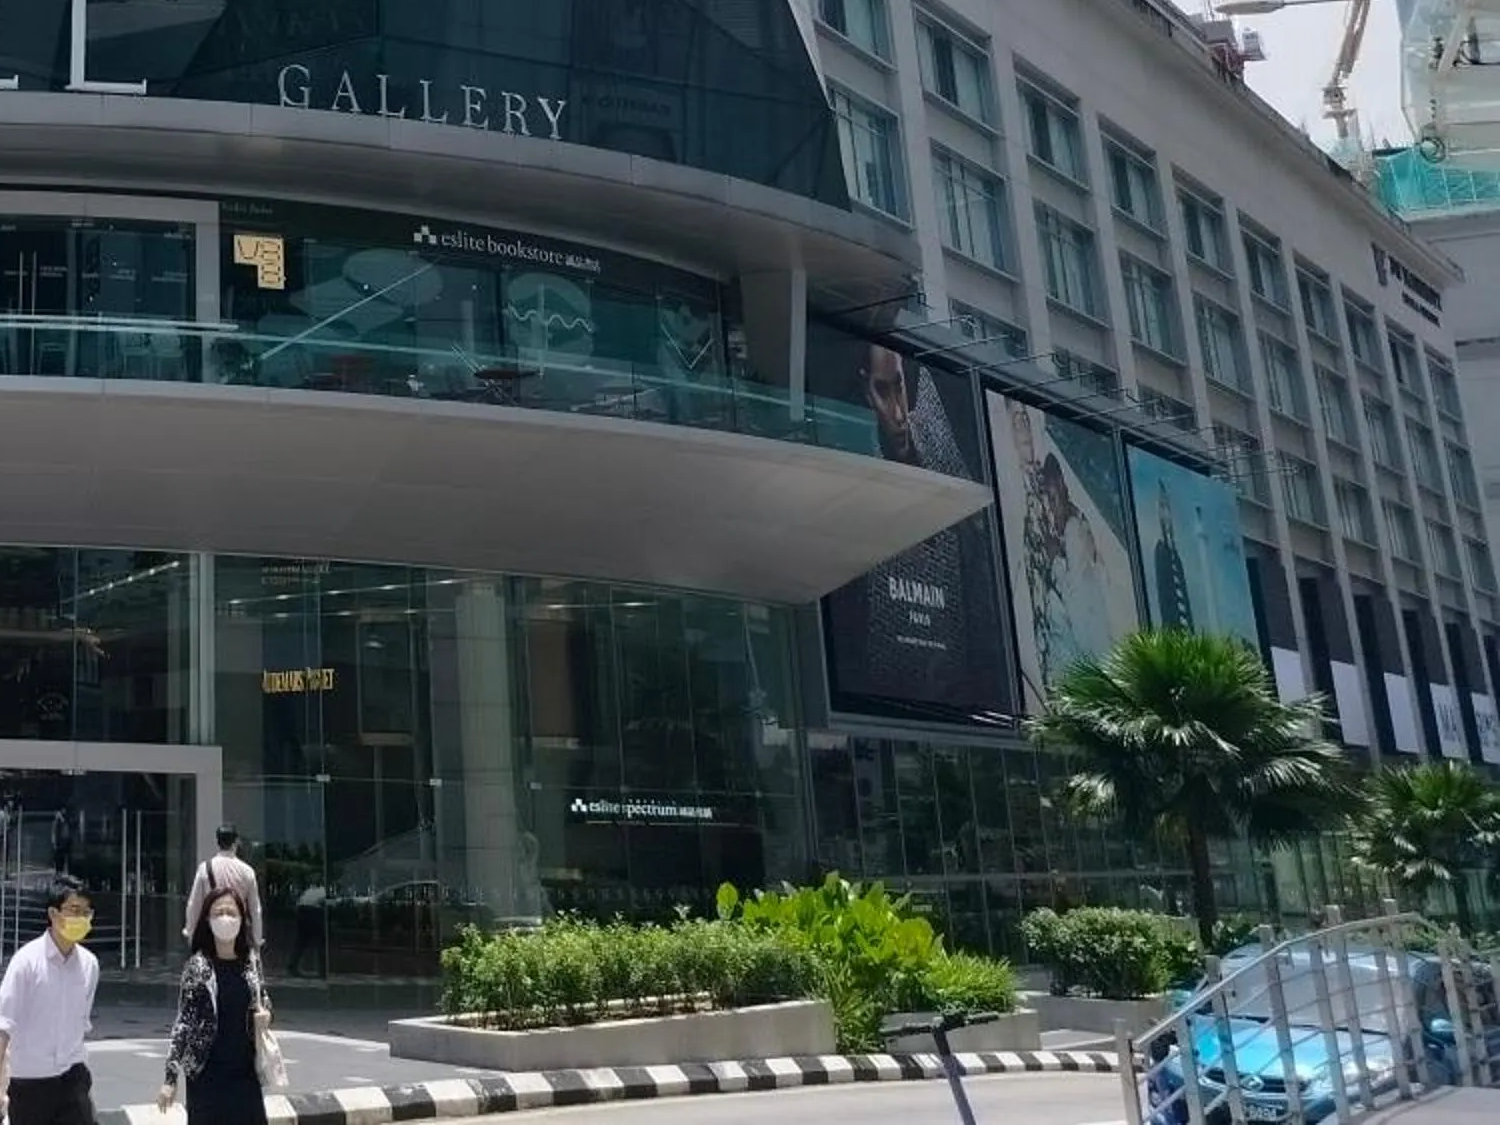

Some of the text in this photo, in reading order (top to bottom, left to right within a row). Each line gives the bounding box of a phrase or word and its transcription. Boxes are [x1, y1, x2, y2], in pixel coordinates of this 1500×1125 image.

[278, 64, 566, 140] GALLERY
[441, 230, 485, 252] eslite
[488, 235, 563, 266] bookstore
[889, 577, 945, 610] BALMAIN
